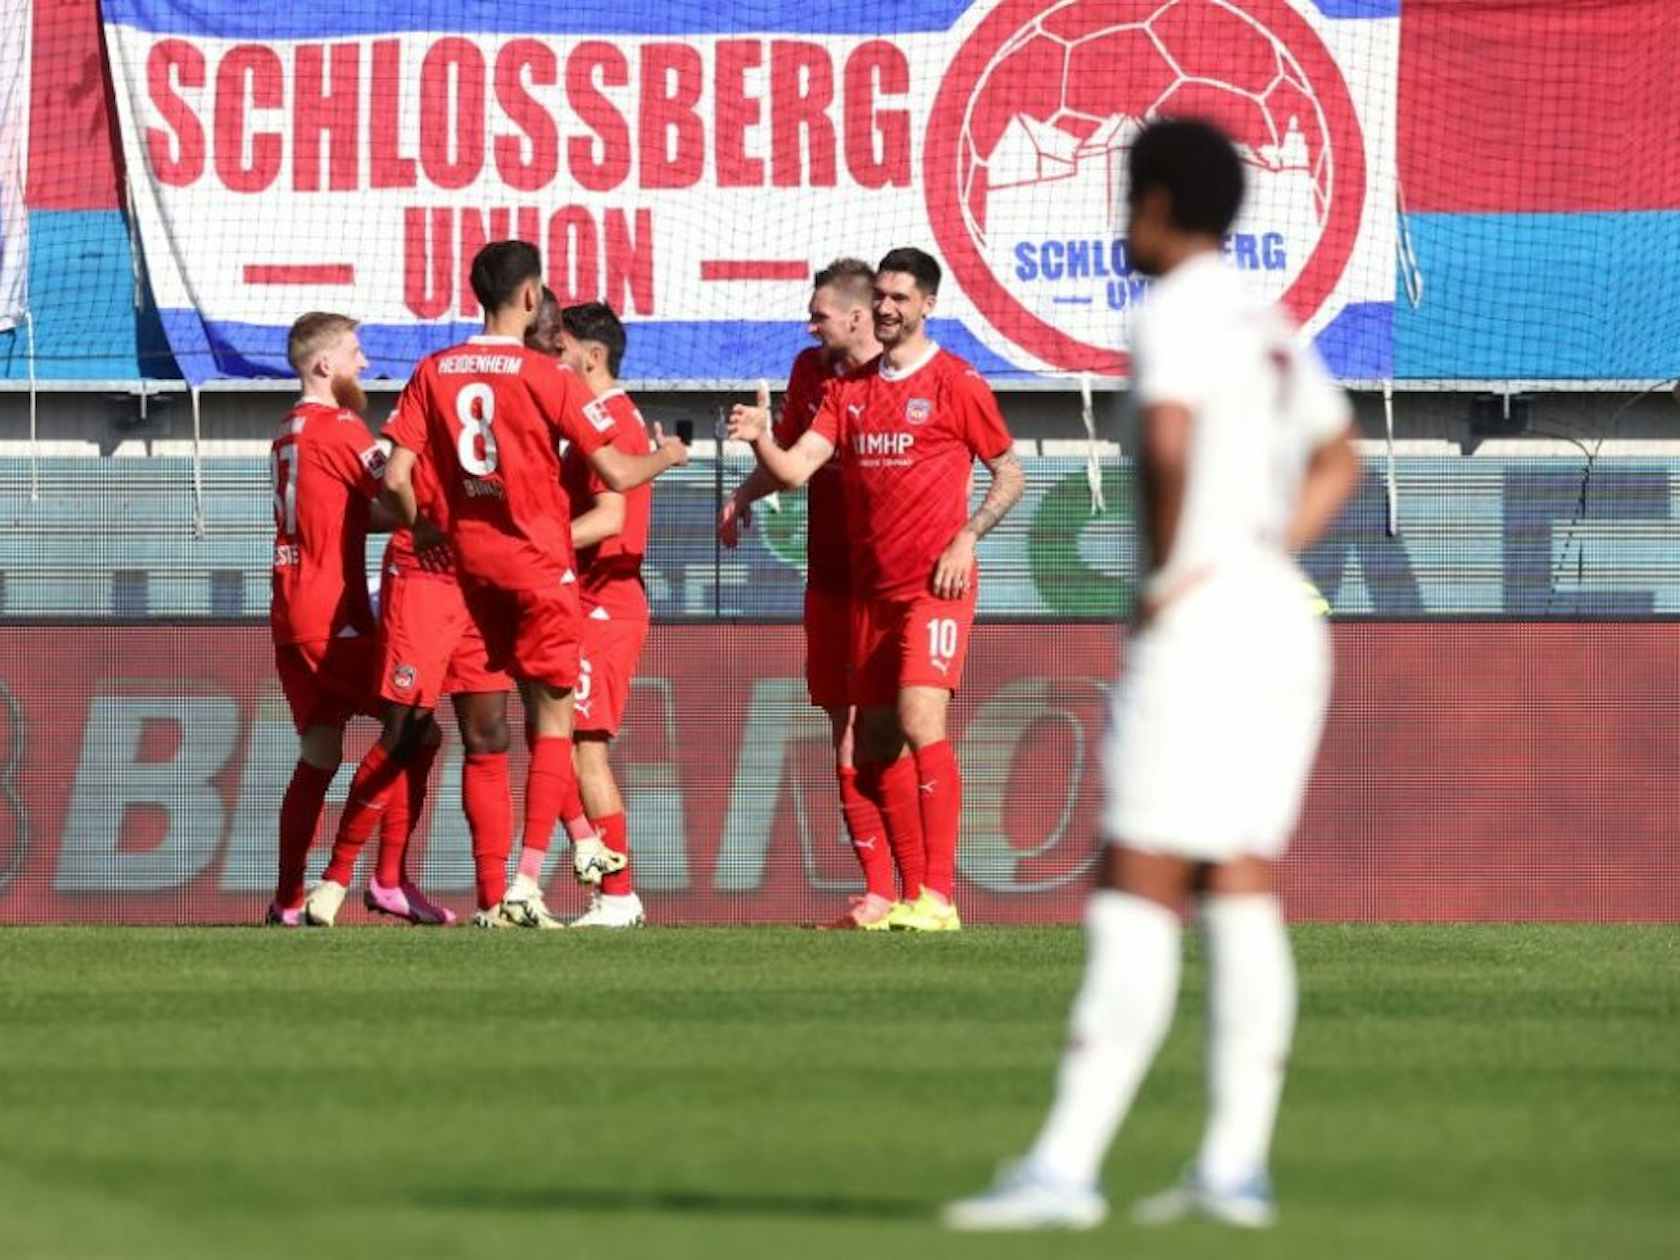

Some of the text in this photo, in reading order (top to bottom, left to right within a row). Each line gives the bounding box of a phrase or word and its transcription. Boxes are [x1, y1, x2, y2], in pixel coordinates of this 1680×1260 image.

[144, 37, 912, 194] SCHLOSSBERG
[438, 354, 523, 375] HEIDENHEIM
[456, 382, 497, 477] 8
[927, 618, 957, 659] 10
